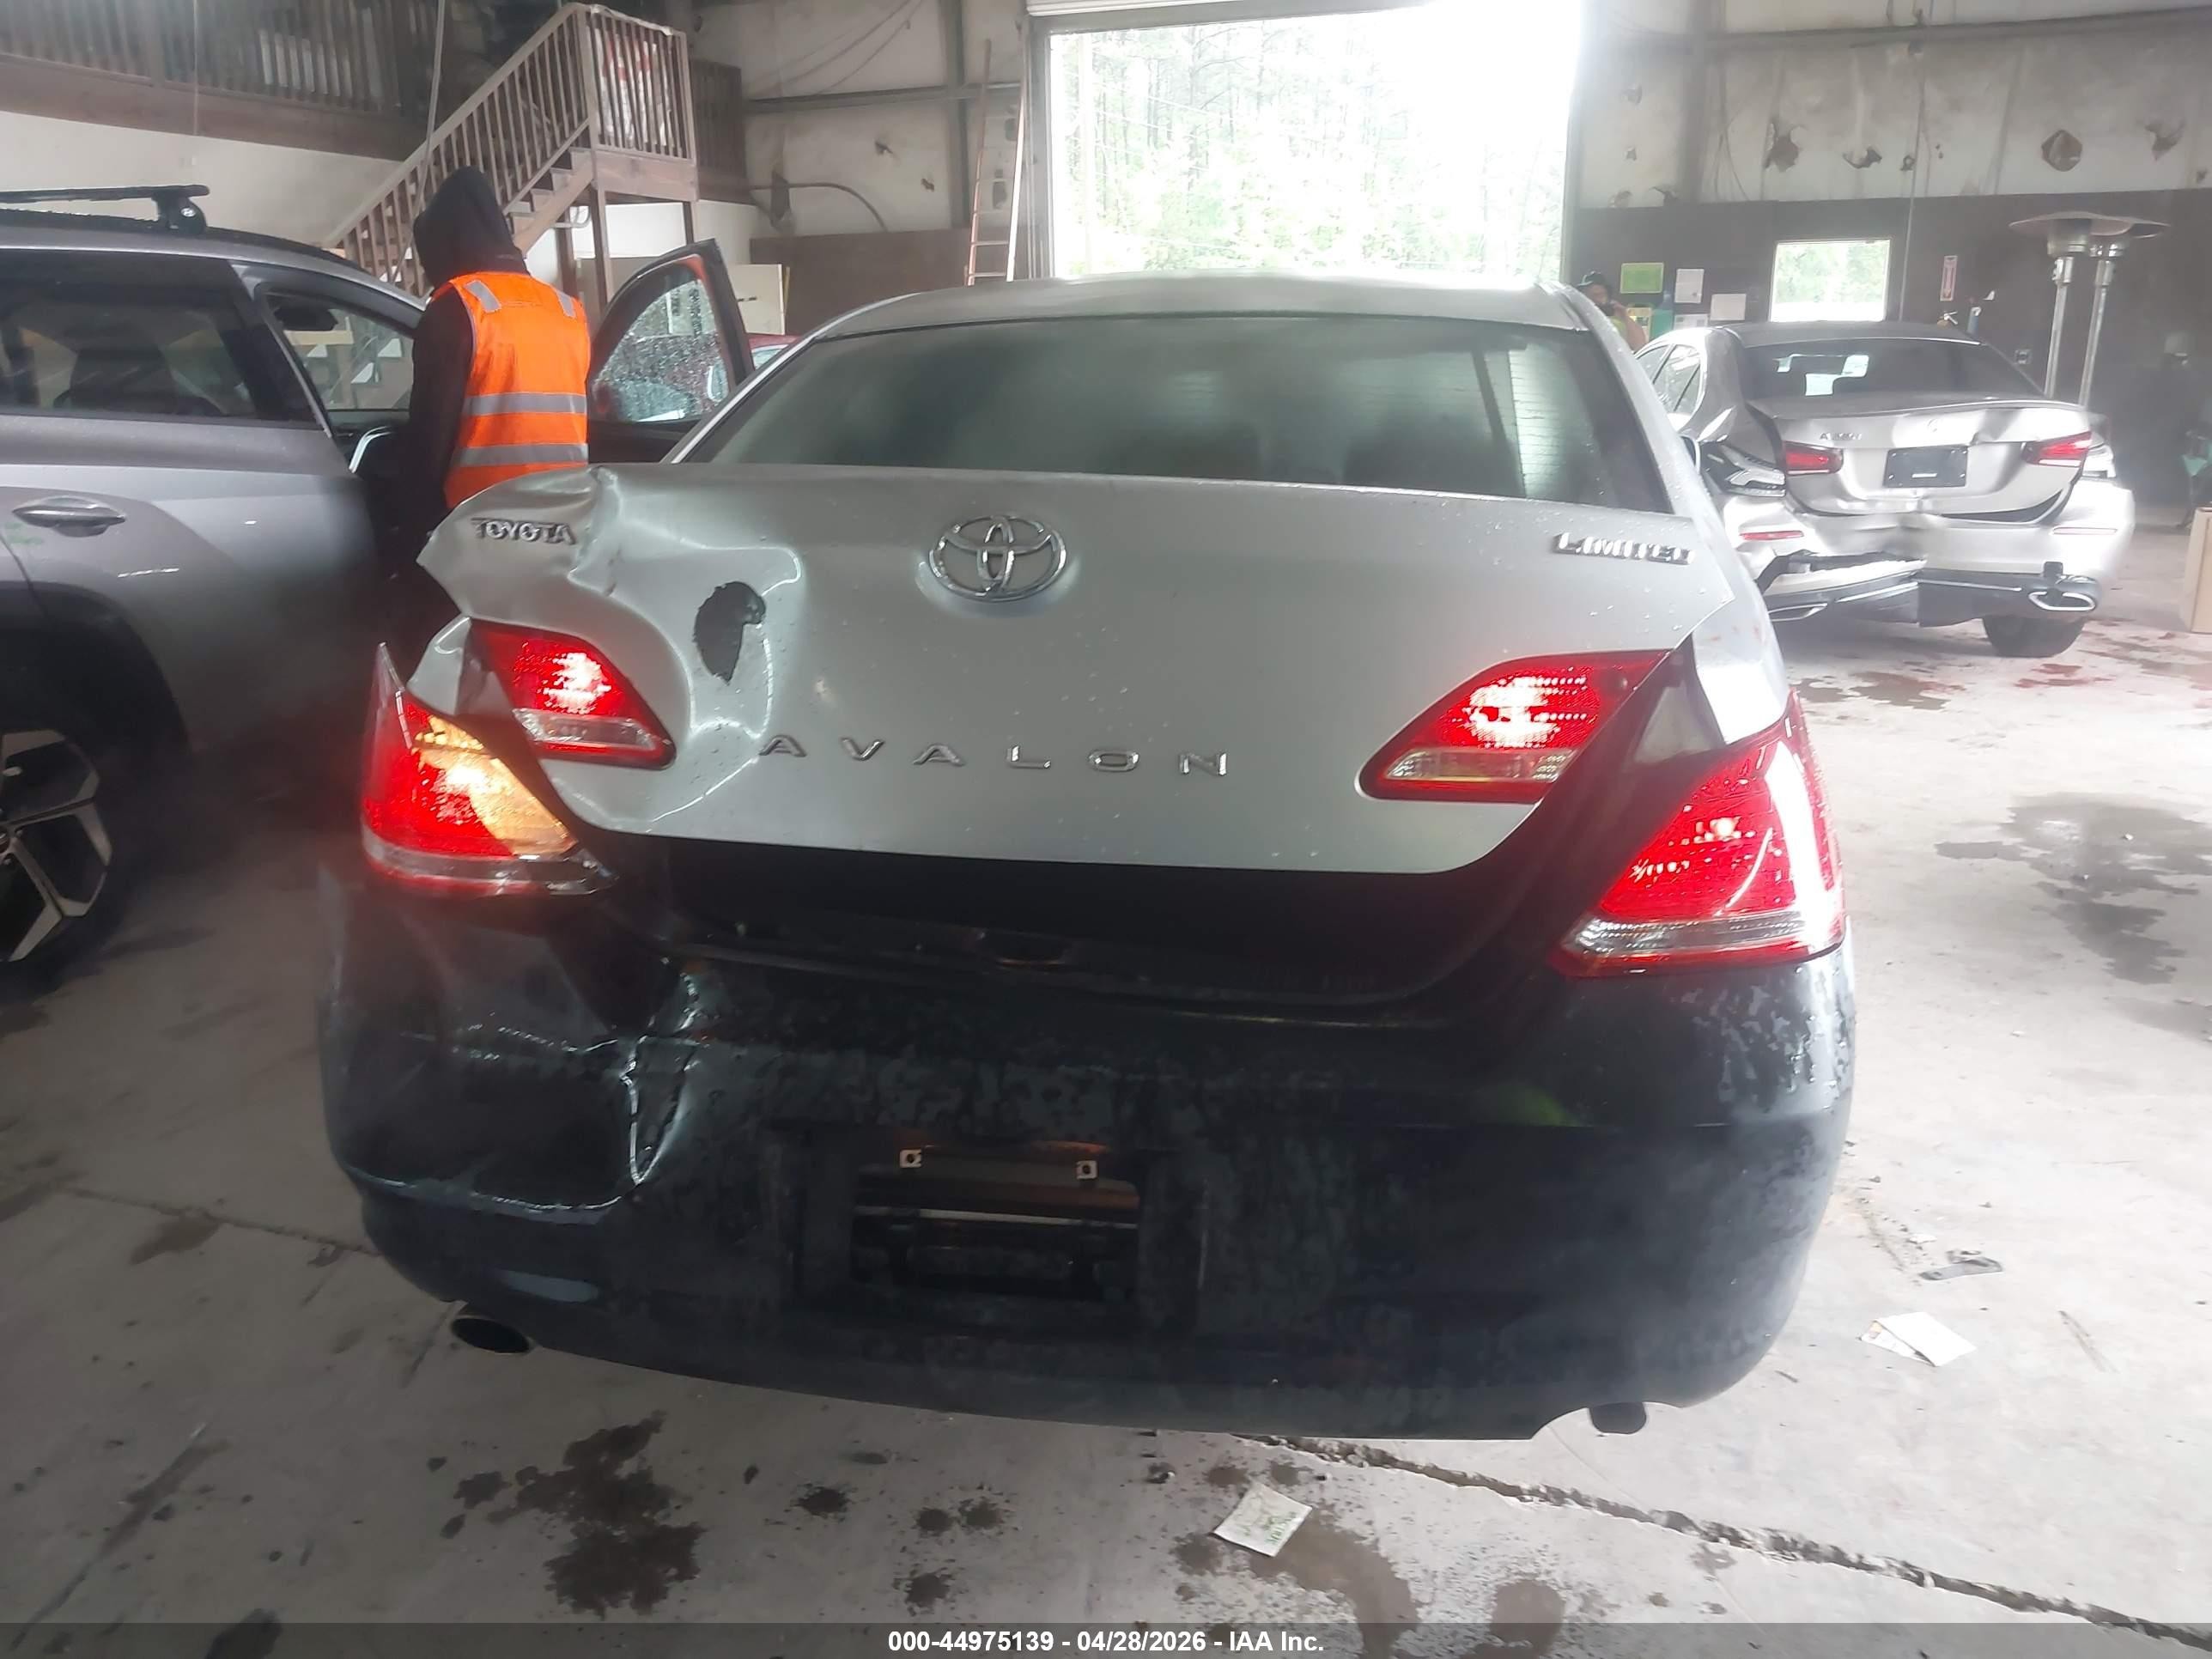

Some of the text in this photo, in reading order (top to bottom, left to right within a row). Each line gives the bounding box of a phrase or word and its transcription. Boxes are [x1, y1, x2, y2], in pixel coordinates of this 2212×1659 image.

[471, 518, 576, 545] TOYOTA
[1553, 532, 1697, 565] LIMITED
[758, 734, 1228, 776] AVALON
